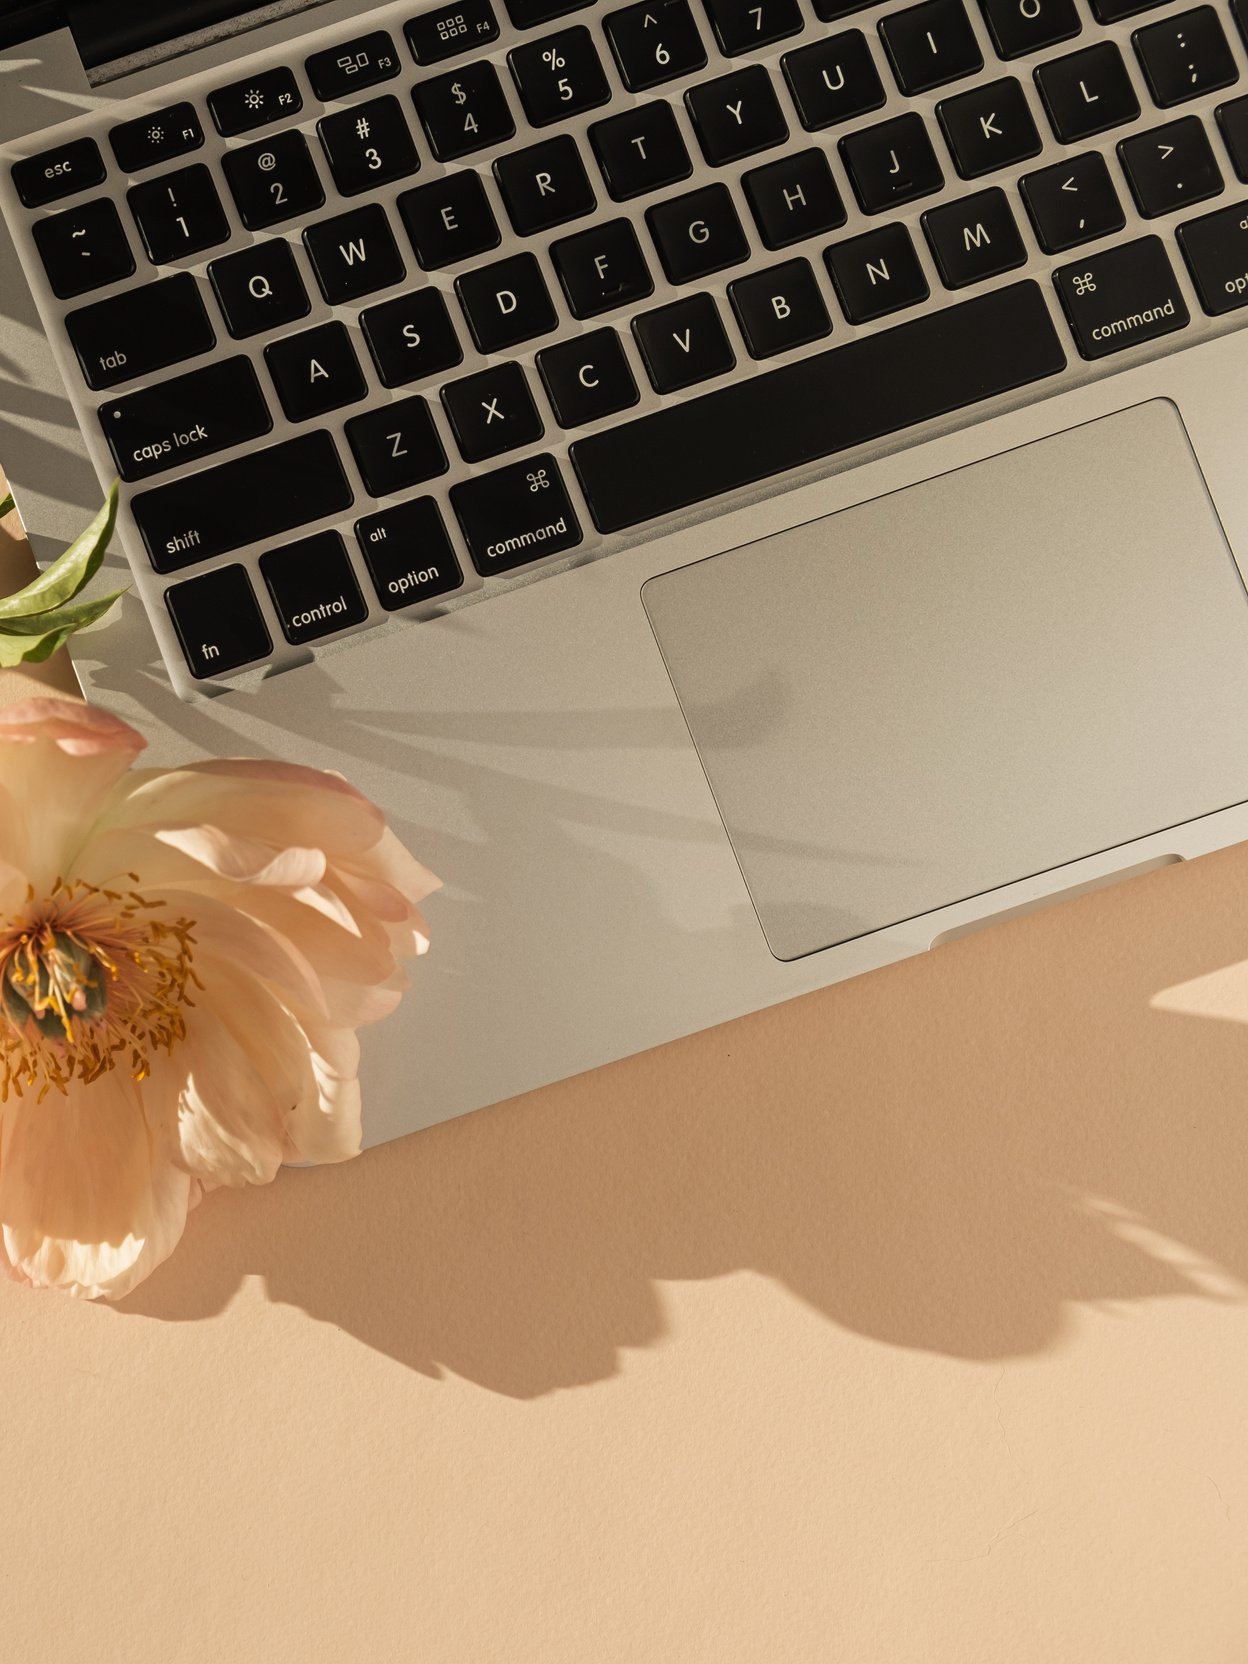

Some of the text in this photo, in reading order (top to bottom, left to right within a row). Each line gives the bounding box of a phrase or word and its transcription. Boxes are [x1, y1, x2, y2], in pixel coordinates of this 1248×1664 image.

[476, 21, 490, 34] F4
[643, 13, 658, 29] ^
[748, 7, 762, 31] 7
[926, 31, 938, 54] I
[1176, 32, 1186, 48] :
[377, 57, 392, 70] F3
[541, 48, 566, 71] %
[655, 42, 671, 65] 6
[821, 64, 845, 91] U
[1188, 64, 1198, 84] ;
[278, 92, 293, 106] F2
[451, 82, 467, 105] $
[557, 77, 573, 101] 5
[1079, 80, 1099, 103] L
[463, 112, 479, 134] 4
[725, 100, 743, 125] Y
[182, 128, 195, 140] F1
[355, 117, 371, 140] #
[979, 112, 1003, 139] K
[365, 148, 382, 170] 3
[630, 136, 647, 160] T
[1157, 144, 1175, 160] >
[44, 161, 72, 179] esc
[257, 152, 277, 171] @
[889, 149, 900, 174] J
[270, 182, 288, 205] 2
[535, 172, 556, 197] R
[1061, 176, 1079, 192] <
[167, 187, 177, 207] !
[782, 184, 807, 211] H
[175, 216, 190, 238] 1
[440, 206, 459, 231] E
[71, 229, 86, 239] ~
[688, 220, 710, 244] G
[963, 222, 991, 252] M
[338, 238, 366, 266] W
[593, 254, 609, 280] F
[865, 258, 891, 286] N
[248, 275, 273, 299] Q
[495, 290, 517, 315] D
[770, 295, 791, 320] B
[1091, 298, 1176, 341] command
[402, 324, 421, 348] S
[672, 328, 690, 353] V
[99, 350, 127, 371] tab
[310, 358, 329, 384] A
[578, 364, 600, 388] C
[481, 397, 505, 425] X
[133, 424, 209, 462] caps lock
[386, 432, 408, 458] Z
[166, 530, 201, 554] shift
[369, 527, 387, 543] alt
[486, 516, 568, 558] command
[388, 566, 440, 594] option
[292, 595, 348, 628] control
[201, 643, 220, 660] fn
